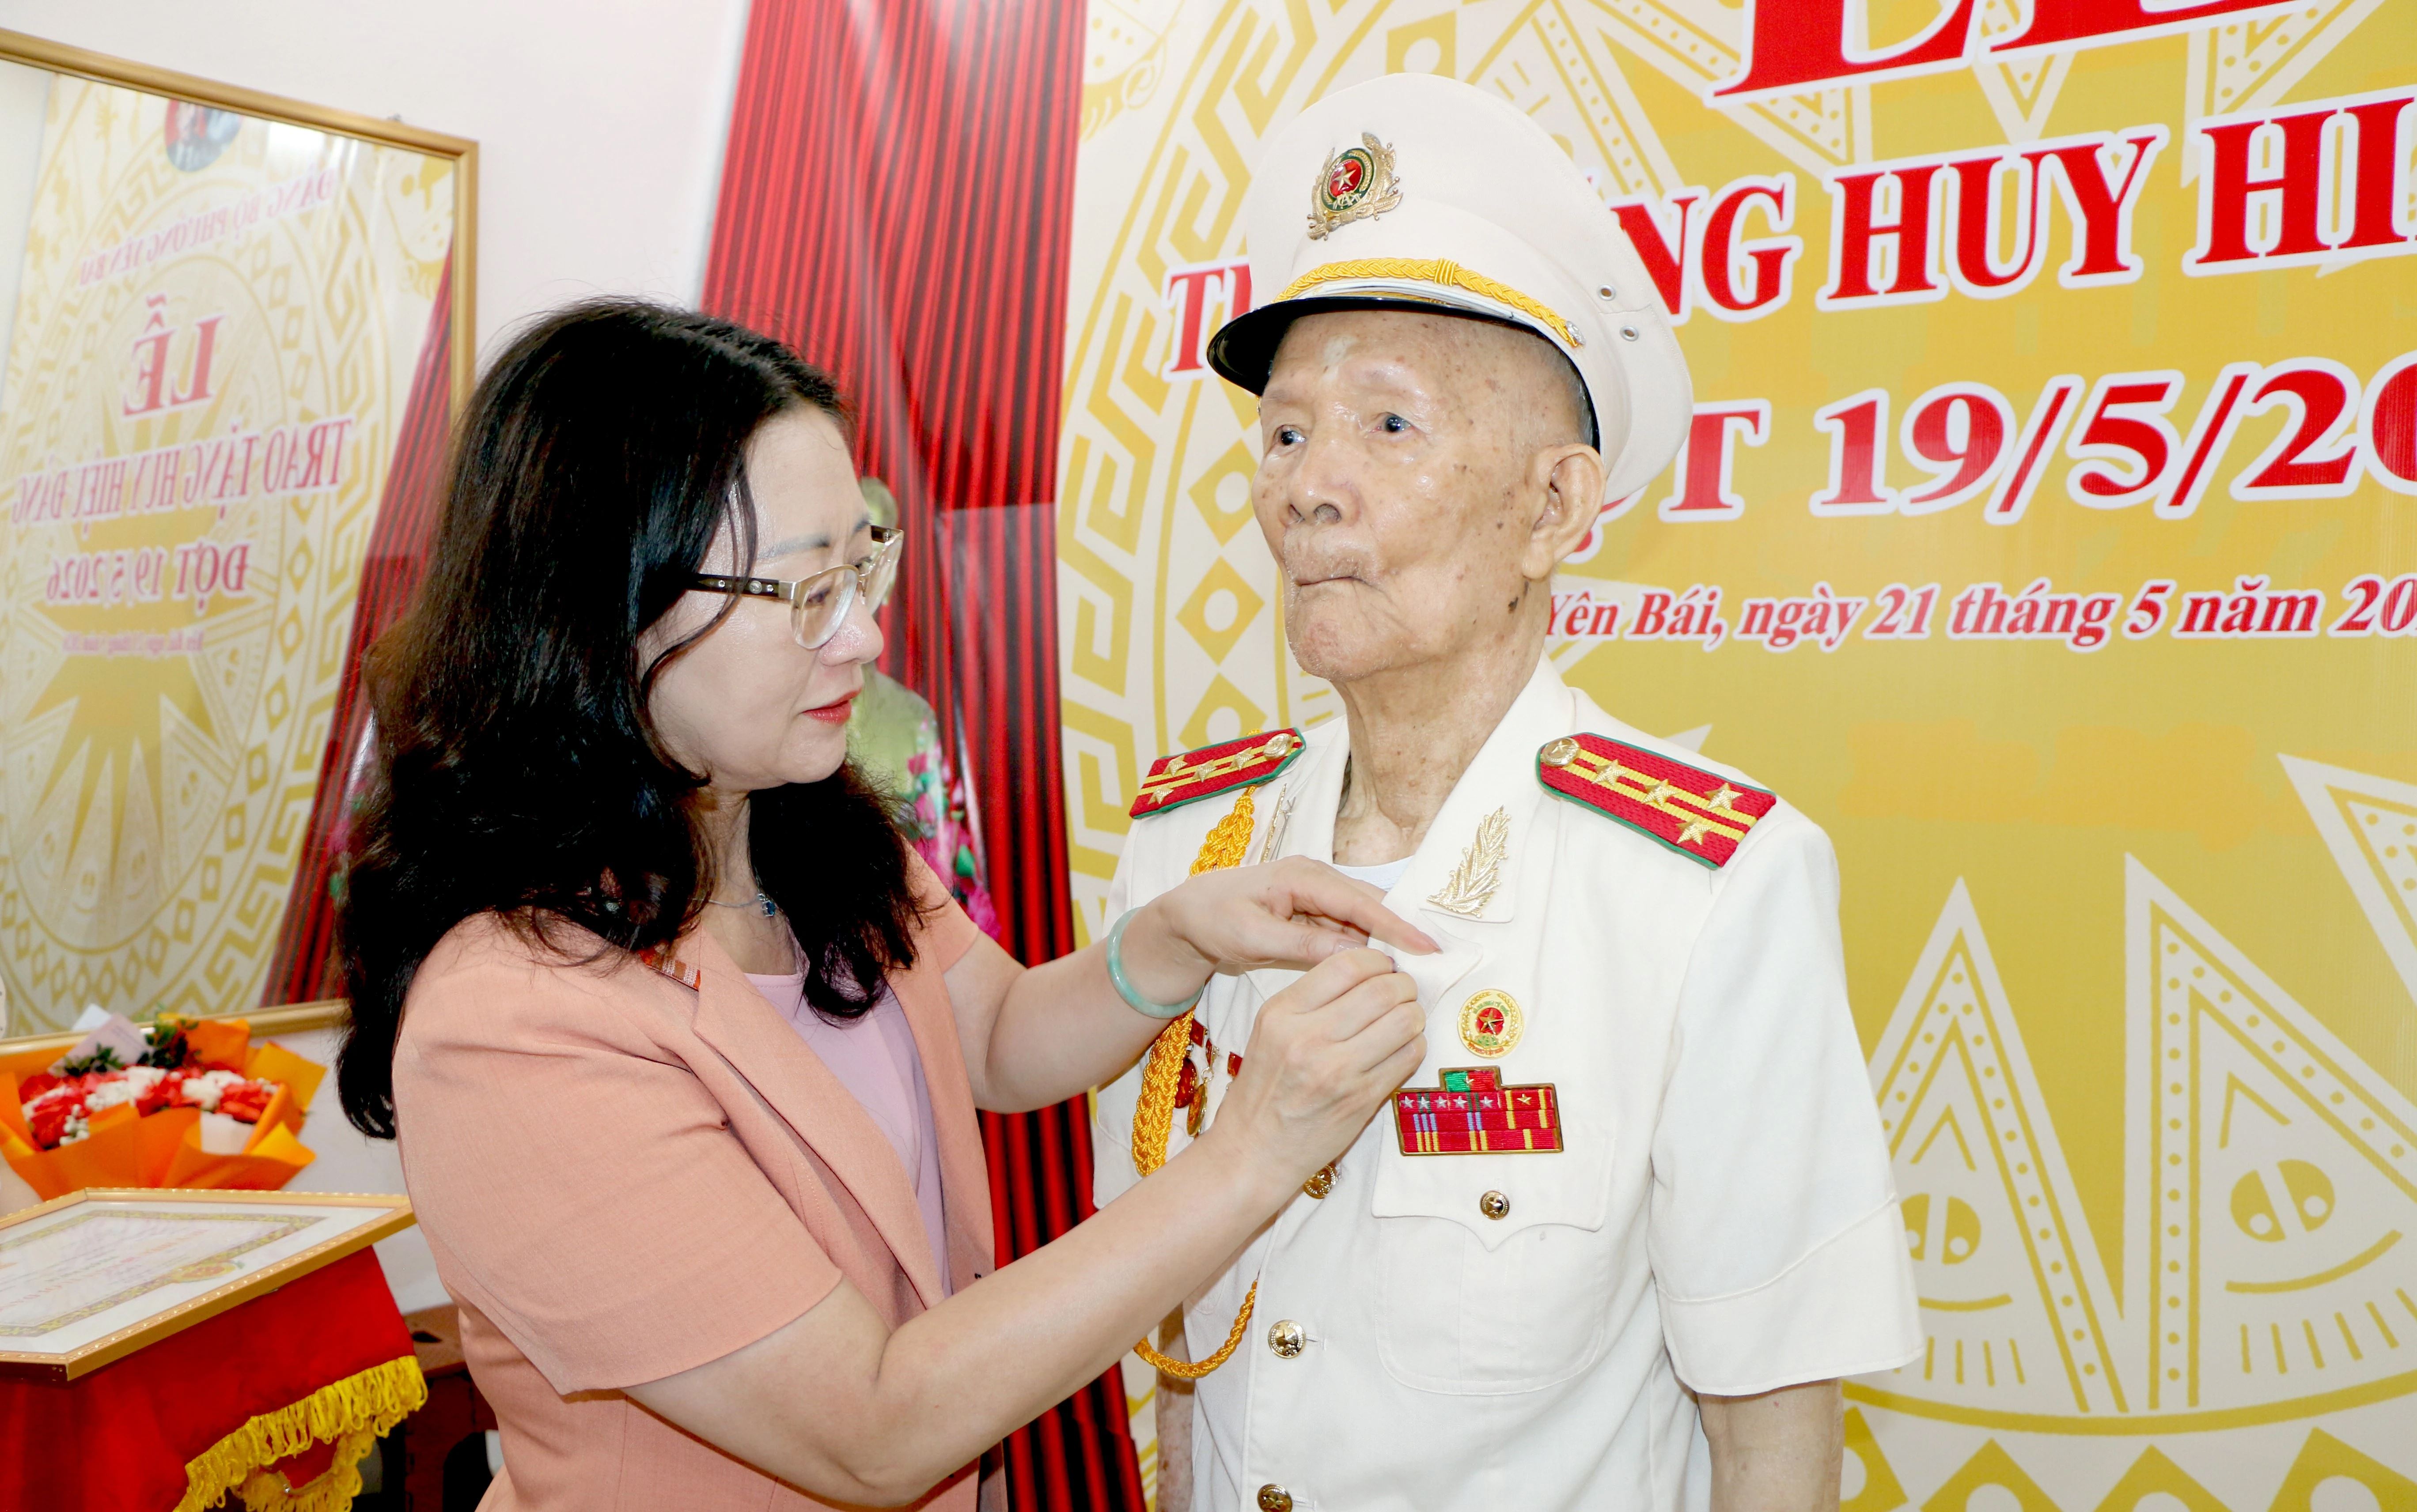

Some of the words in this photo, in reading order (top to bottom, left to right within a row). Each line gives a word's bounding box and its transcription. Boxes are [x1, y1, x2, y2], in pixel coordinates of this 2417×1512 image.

[1610, 182, 1792, 316] NG
[1826, 134, 2159, 300] HUY
[2195, 97, 2417, 264] HI
[1546, 590, 1618, 635] Yên
[1629, 588, 1723, 646] Bái,
[1739, 587, 1863, 648] ngày
[1870, 587, 1937, 634] 21
[1952, 581, 2116, 647] tháng
[2128, 584, 2171, 634] 5
[2176, 579, 2319, 633] năm
[2335, 579, 2417, 631] 20
